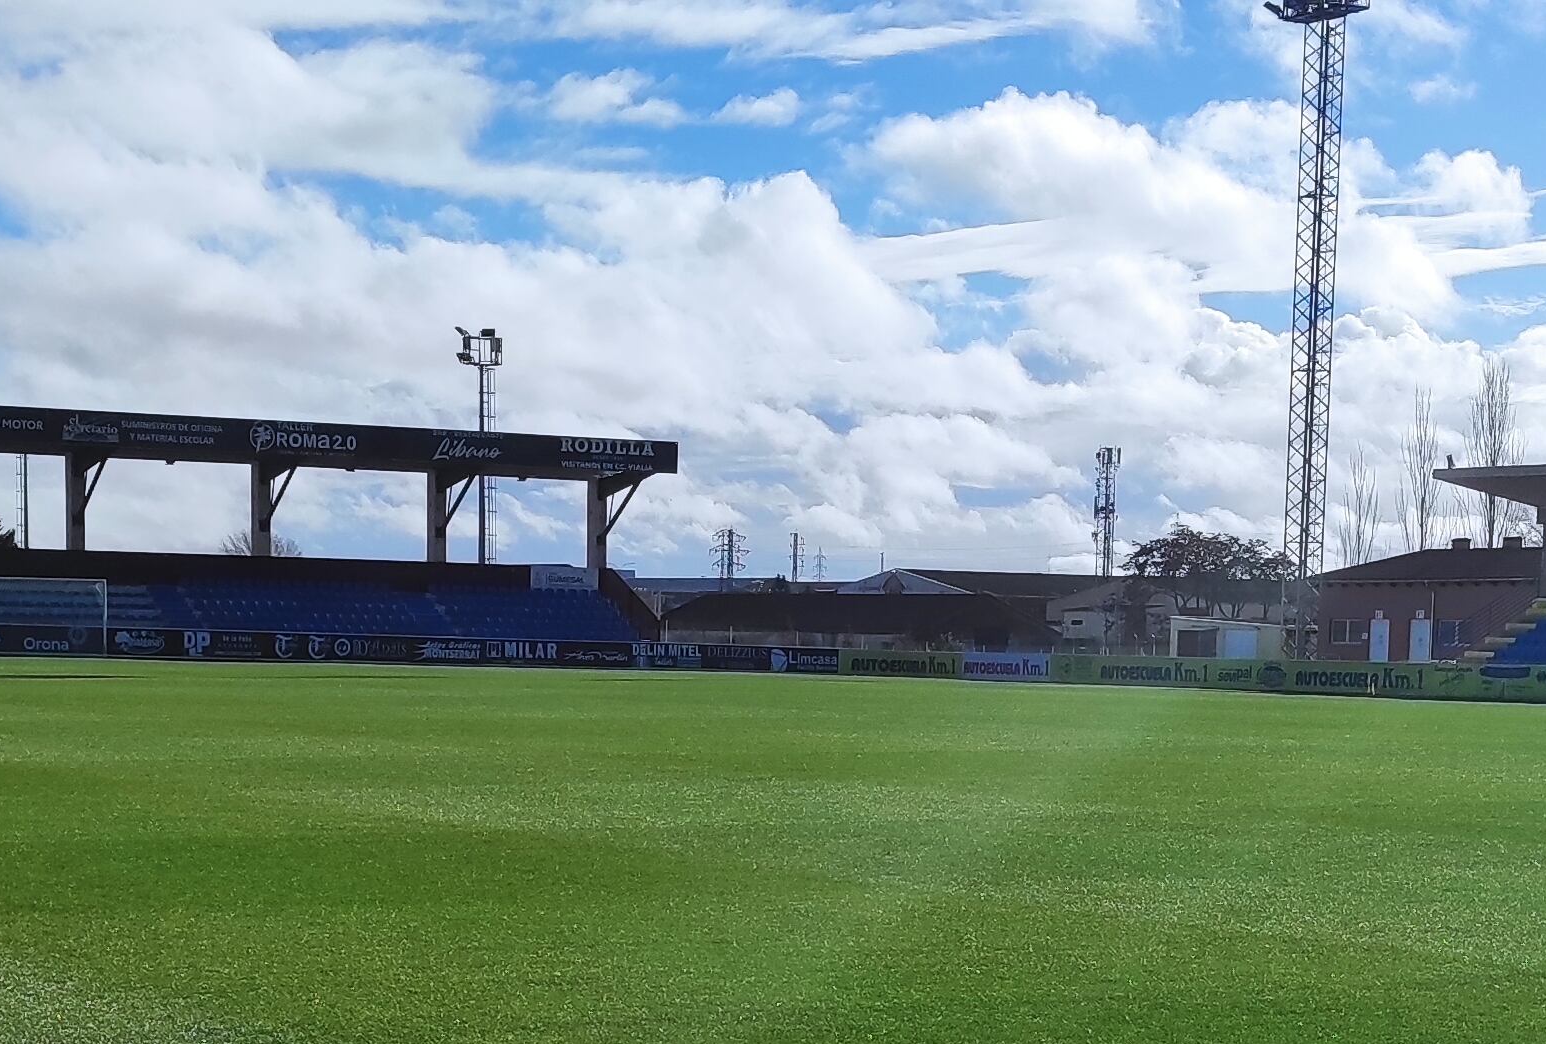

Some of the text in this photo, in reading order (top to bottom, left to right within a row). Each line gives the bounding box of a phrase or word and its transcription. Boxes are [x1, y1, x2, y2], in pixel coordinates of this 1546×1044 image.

[2, 418, 43, 431] MOTOR
[121, 420, 176, 431] SUMINISTROS
[178, 423, 189, 432] DE
[277, 421, 314, 432] TALLER
[129, 432, 215, 445] Y MATERIAL ESCOLAR
[560, 437, 655, 456] RODILLA
[23, 637, 69, 651] Orona
[504, 642, 558, 659] MILAR
[668, 644, 701, 657] MITEL
[789, 650, 838, 665] Limcasa
[851, 658, 927, 672] AUTOESCUELA
[964, 661, 1020, 675] AUTOESCUELA
[1100, 664, 1172, 681] AUTOESCUELA
[1294, 670, 1379, 687] AUTOESCUELA
